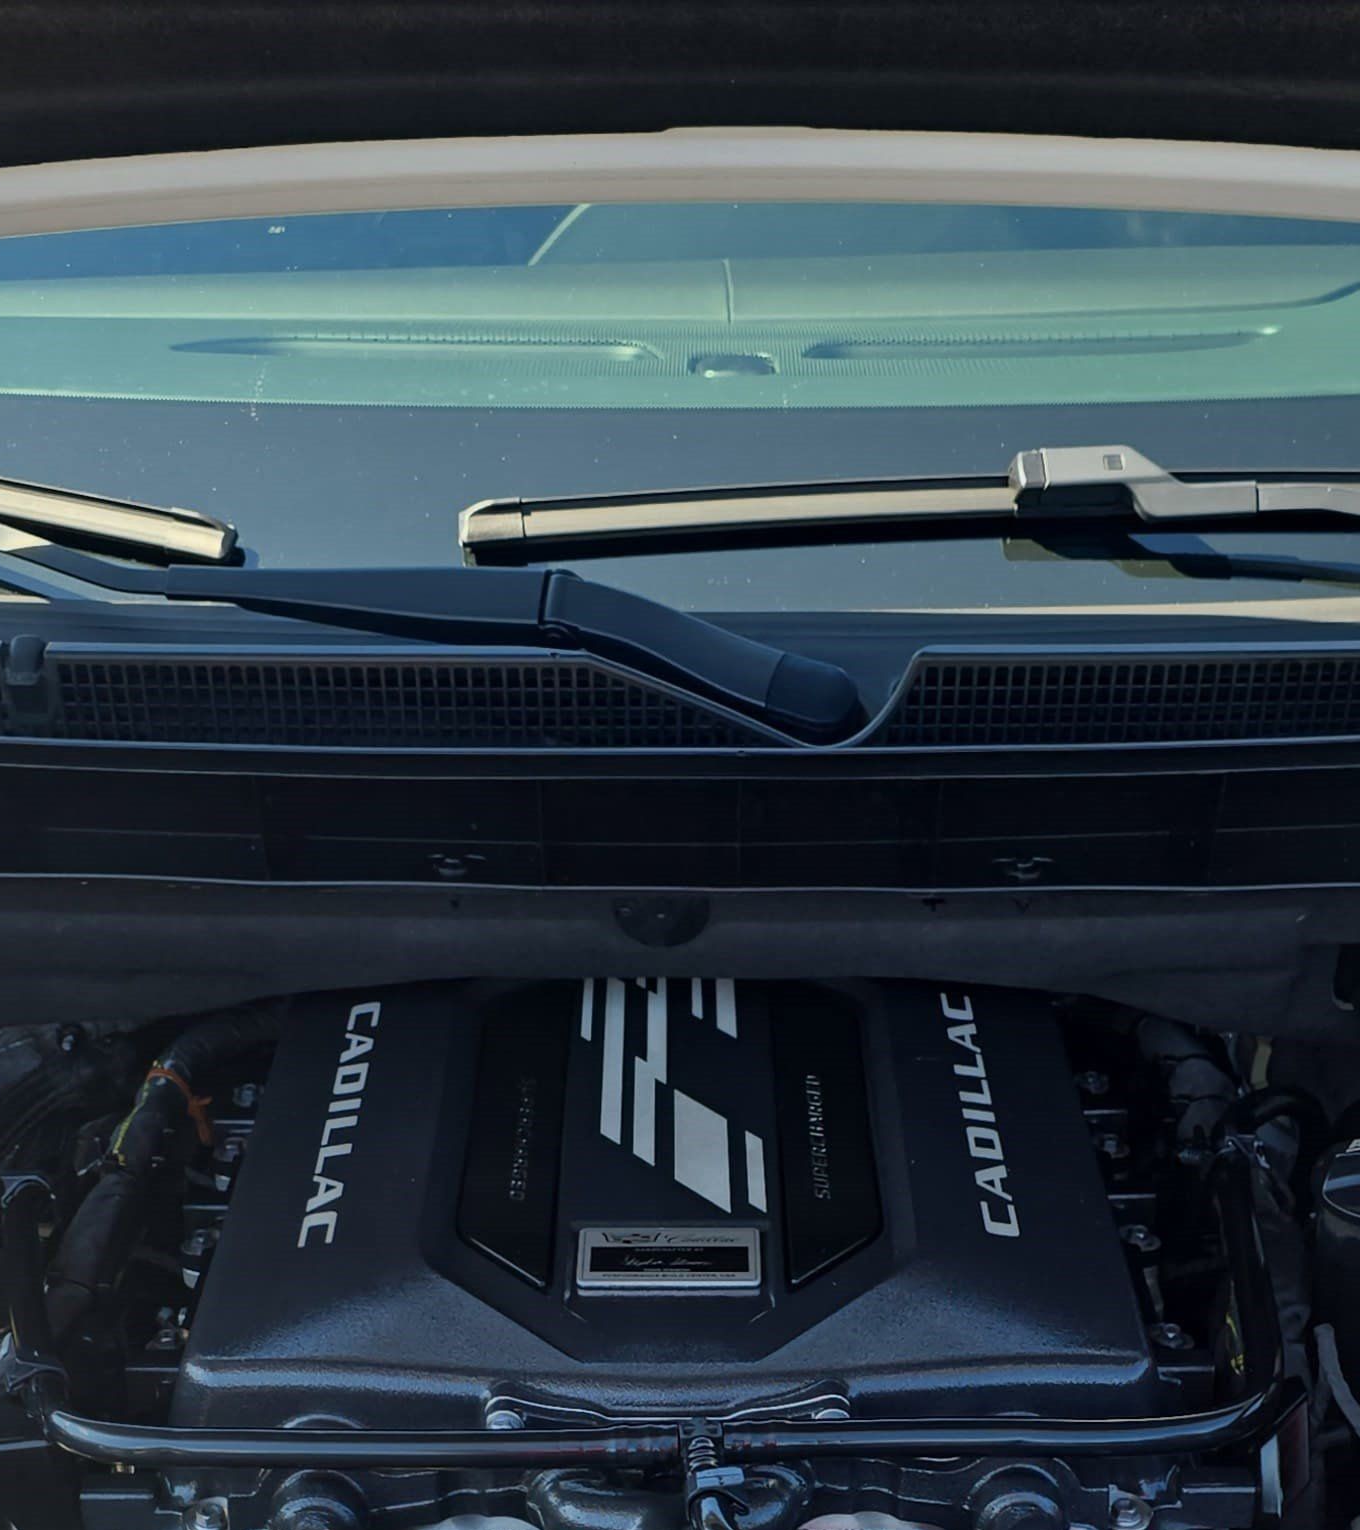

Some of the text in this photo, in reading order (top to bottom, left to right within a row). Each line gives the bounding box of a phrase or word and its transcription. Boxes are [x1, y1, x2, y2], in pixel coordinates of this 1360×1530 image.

[296, 1001, 381, 1249] CADILLAC
[805, 1074, 833, 1201] SUPERCHARGED
[941, 991, 1021, 1239] CADILLAC
